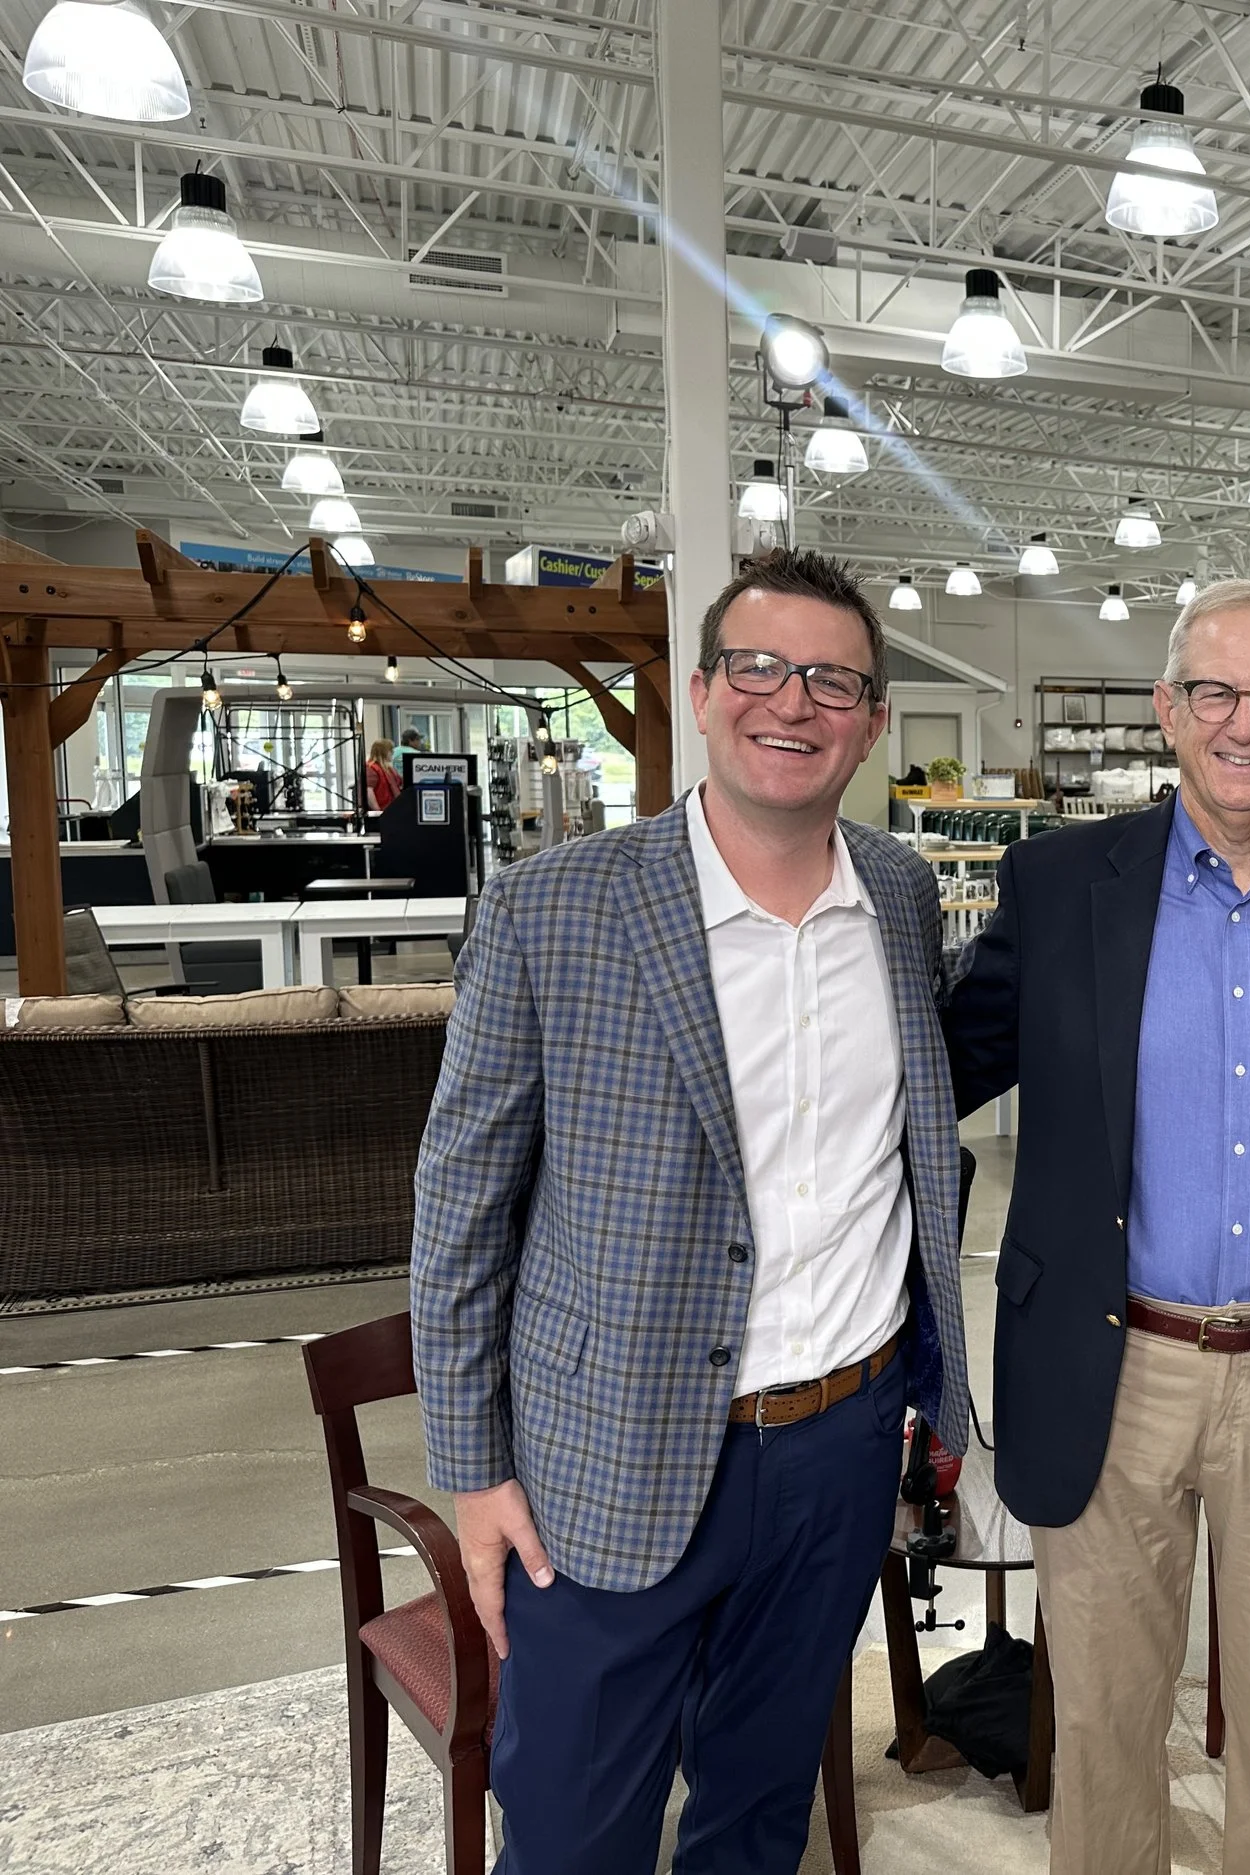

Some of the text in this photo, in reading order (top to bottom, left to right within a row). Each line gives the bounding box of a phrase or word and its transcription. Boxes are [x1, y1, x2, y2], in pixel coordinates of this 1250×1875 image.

[540, 556, 582, 577] Cashier/
[415, 764, 466, 773] SCAN HERE
